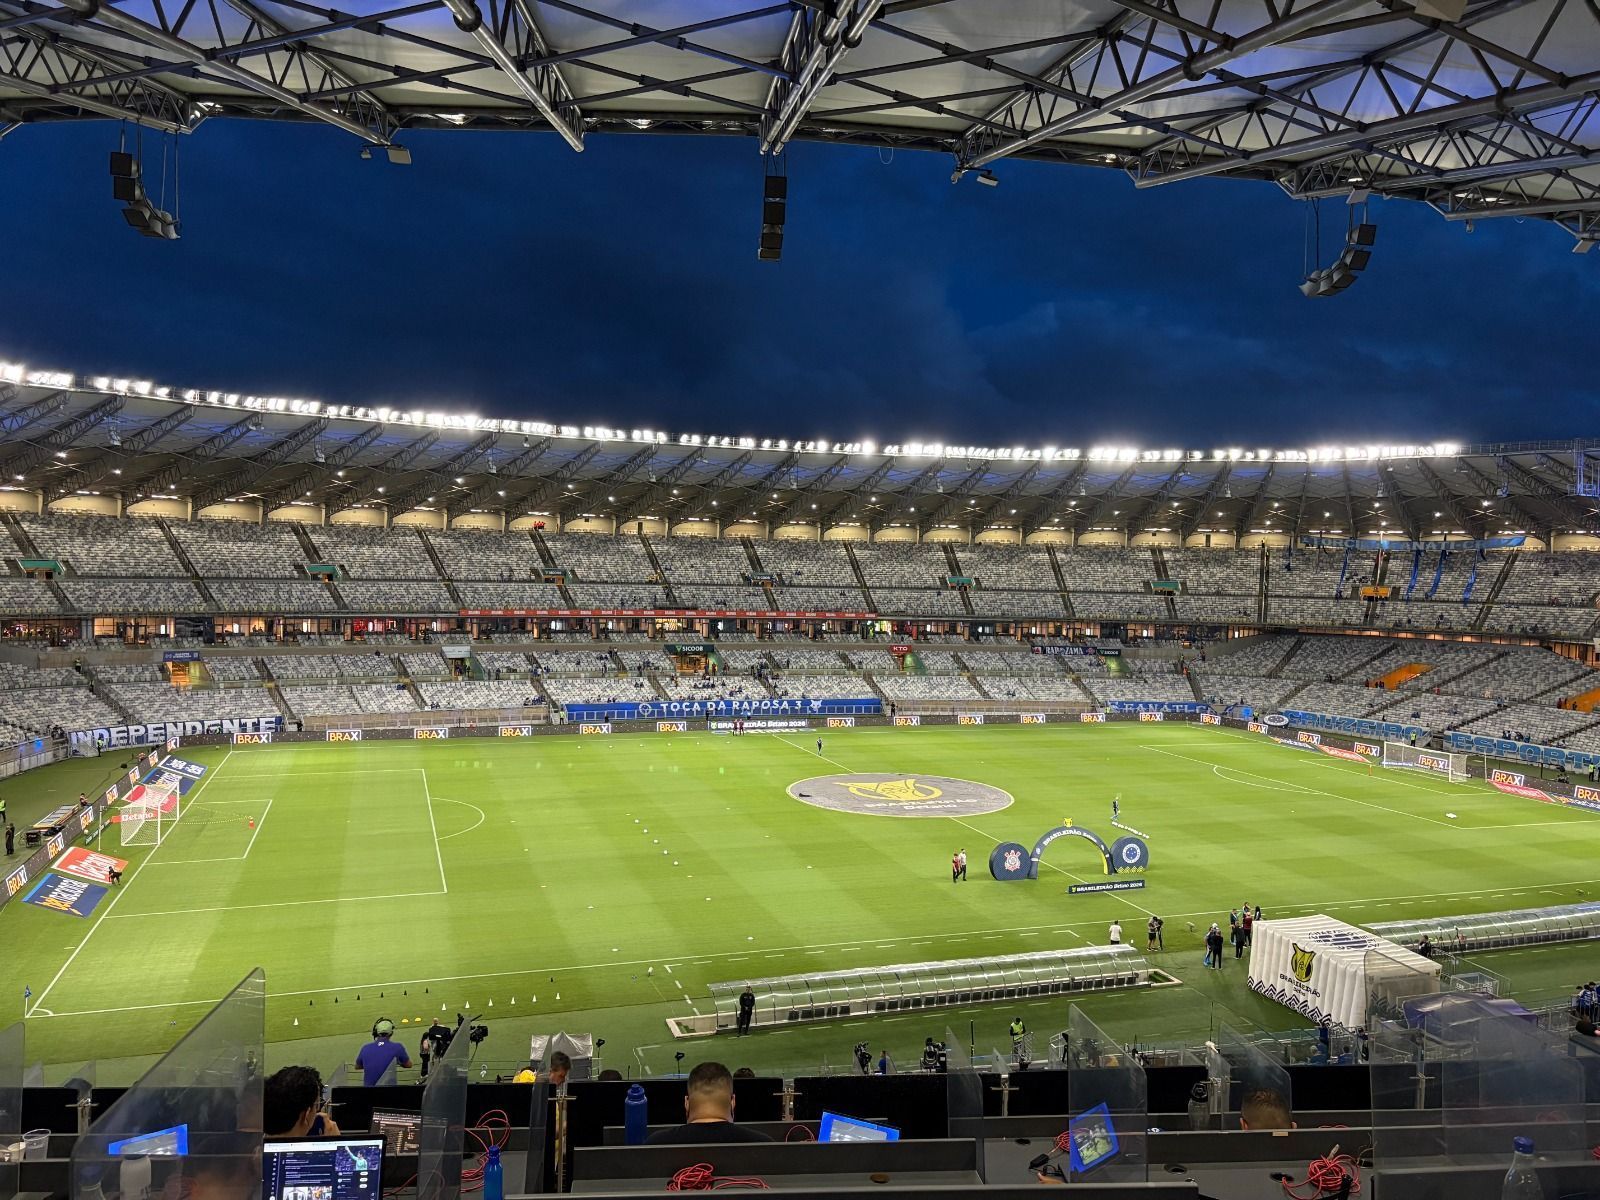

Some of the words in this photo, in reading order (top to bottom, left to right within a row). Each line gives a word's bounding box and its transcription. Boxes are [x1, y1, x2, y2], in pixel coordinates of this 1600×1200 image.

[660, 702, 701, 712] TOCA
[707, 701, 727, 711] DA
[732, 700, 790, 710] RAPOSA
[795, 700, 802, 709] 3
[718, 720, 766, 728] BRAEIRÃO
[829, 719, 851, 727] BRAX
[896, 717, 918, 726] BRAX
[960, 716, 982, 724] BRAX
[1023, 716, 1043, 724] BRAX
[1203, 716, 1219, 725] BRAX
[1284, 709, 1424, 739] CRUZEIRO
[502, 727, 528, 736] BRAX
[582, 726, 608, 734] BRAX
[660, 724, 684, 732] BRAX
[1250, 724, 1266, 734] BRAX
[330, 732, 359, 741] BRAX
[417, 730, 446, 738] BRAX
[237, 734, 268, 744] BRAX
[1300, 734, 1318, 744] BRAX
[1356, 745, 1378, 756] BRAX
[1450, 732, 1600, 769] ESPORT
[1421, 757, 1444, 768] BRAX
[1495, 772, 1521, 786] BRAX
[1578, 788, 1600, 802] BRA
[9, 869, 27, 895] BRAX
